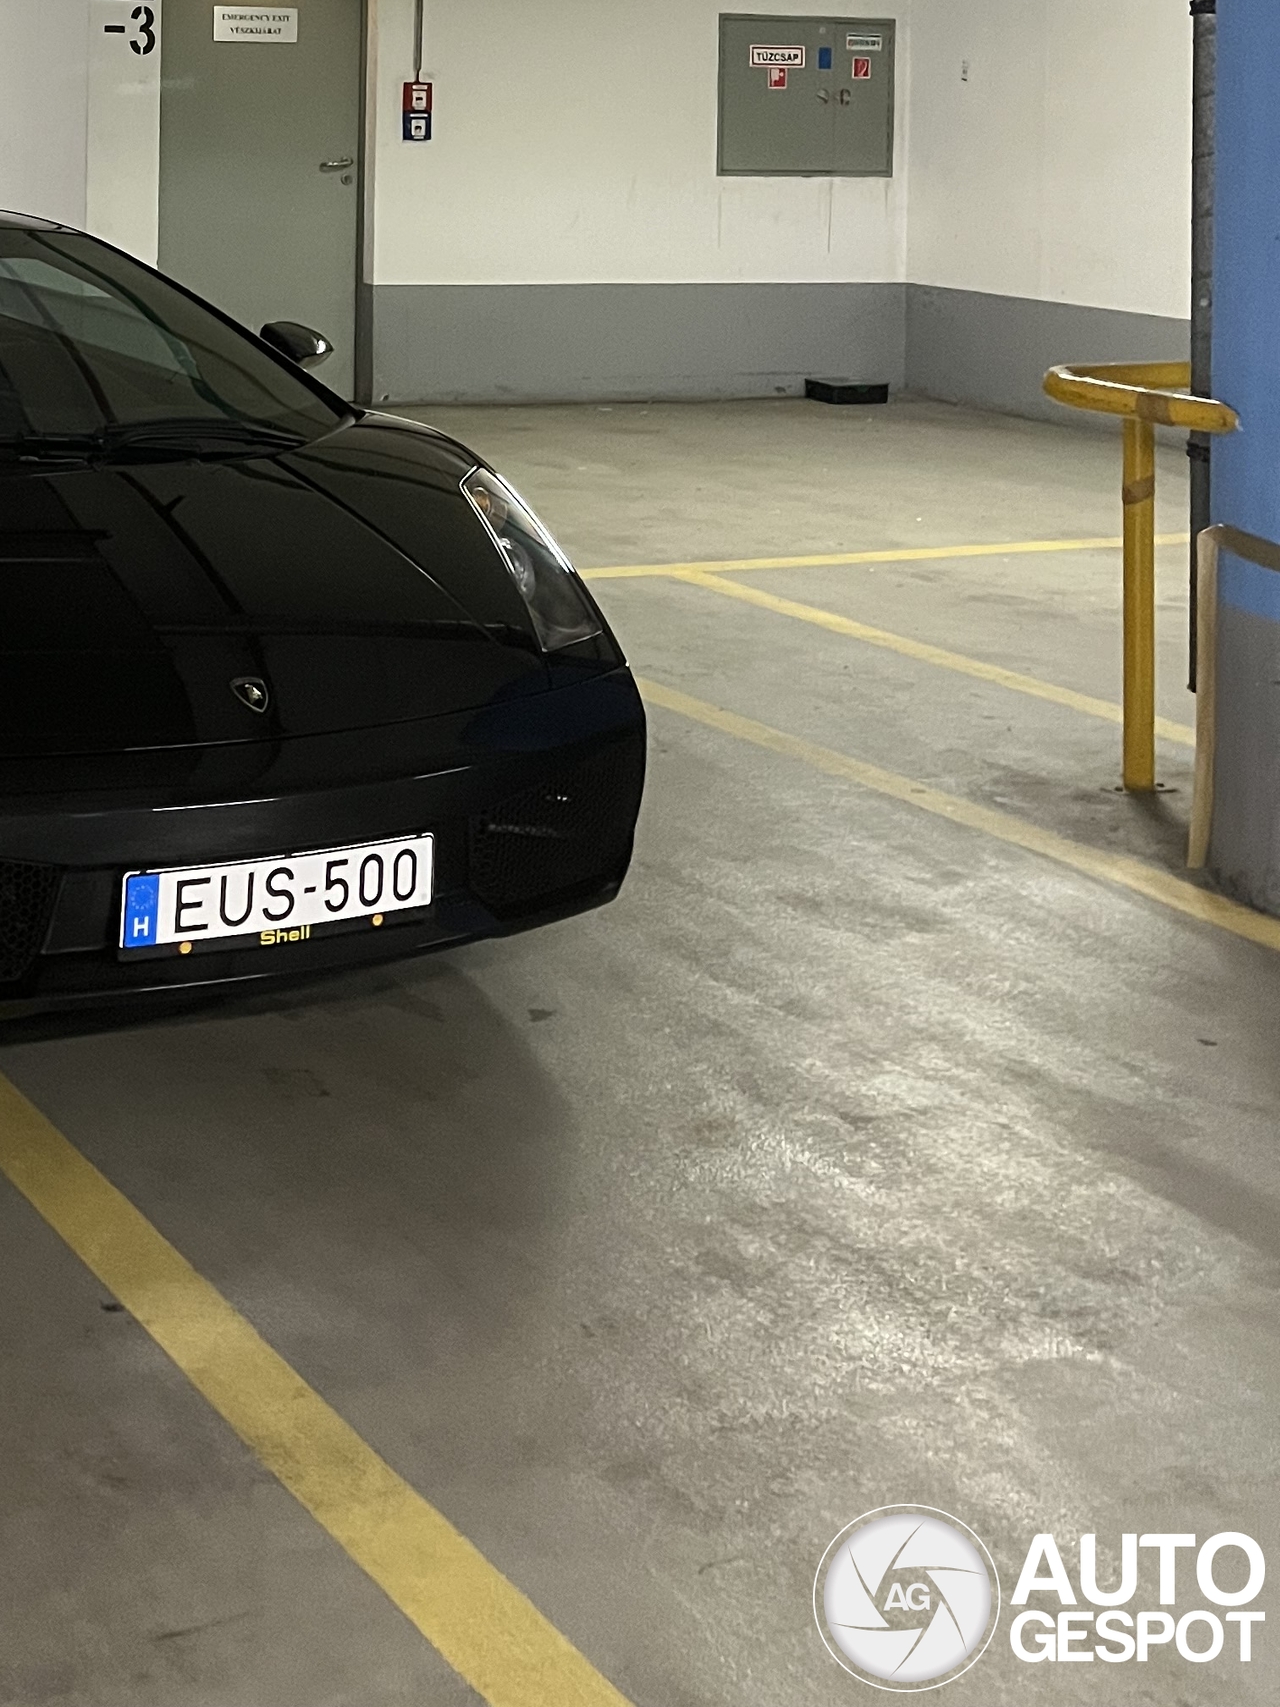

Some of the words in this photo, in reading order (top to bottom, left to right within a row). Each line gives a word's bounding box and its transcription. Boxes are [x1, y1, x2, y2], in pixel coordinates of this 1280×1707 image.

[222, 13, 270, 22] EMERGENCY
[272, 14, 291, 22] EXIT
[104, 6, 155, 55] -3
[175, 848, 417, 933] EUS-500
[133, 916, 149, 938] H
[260, 924, 310, 946] Shell
